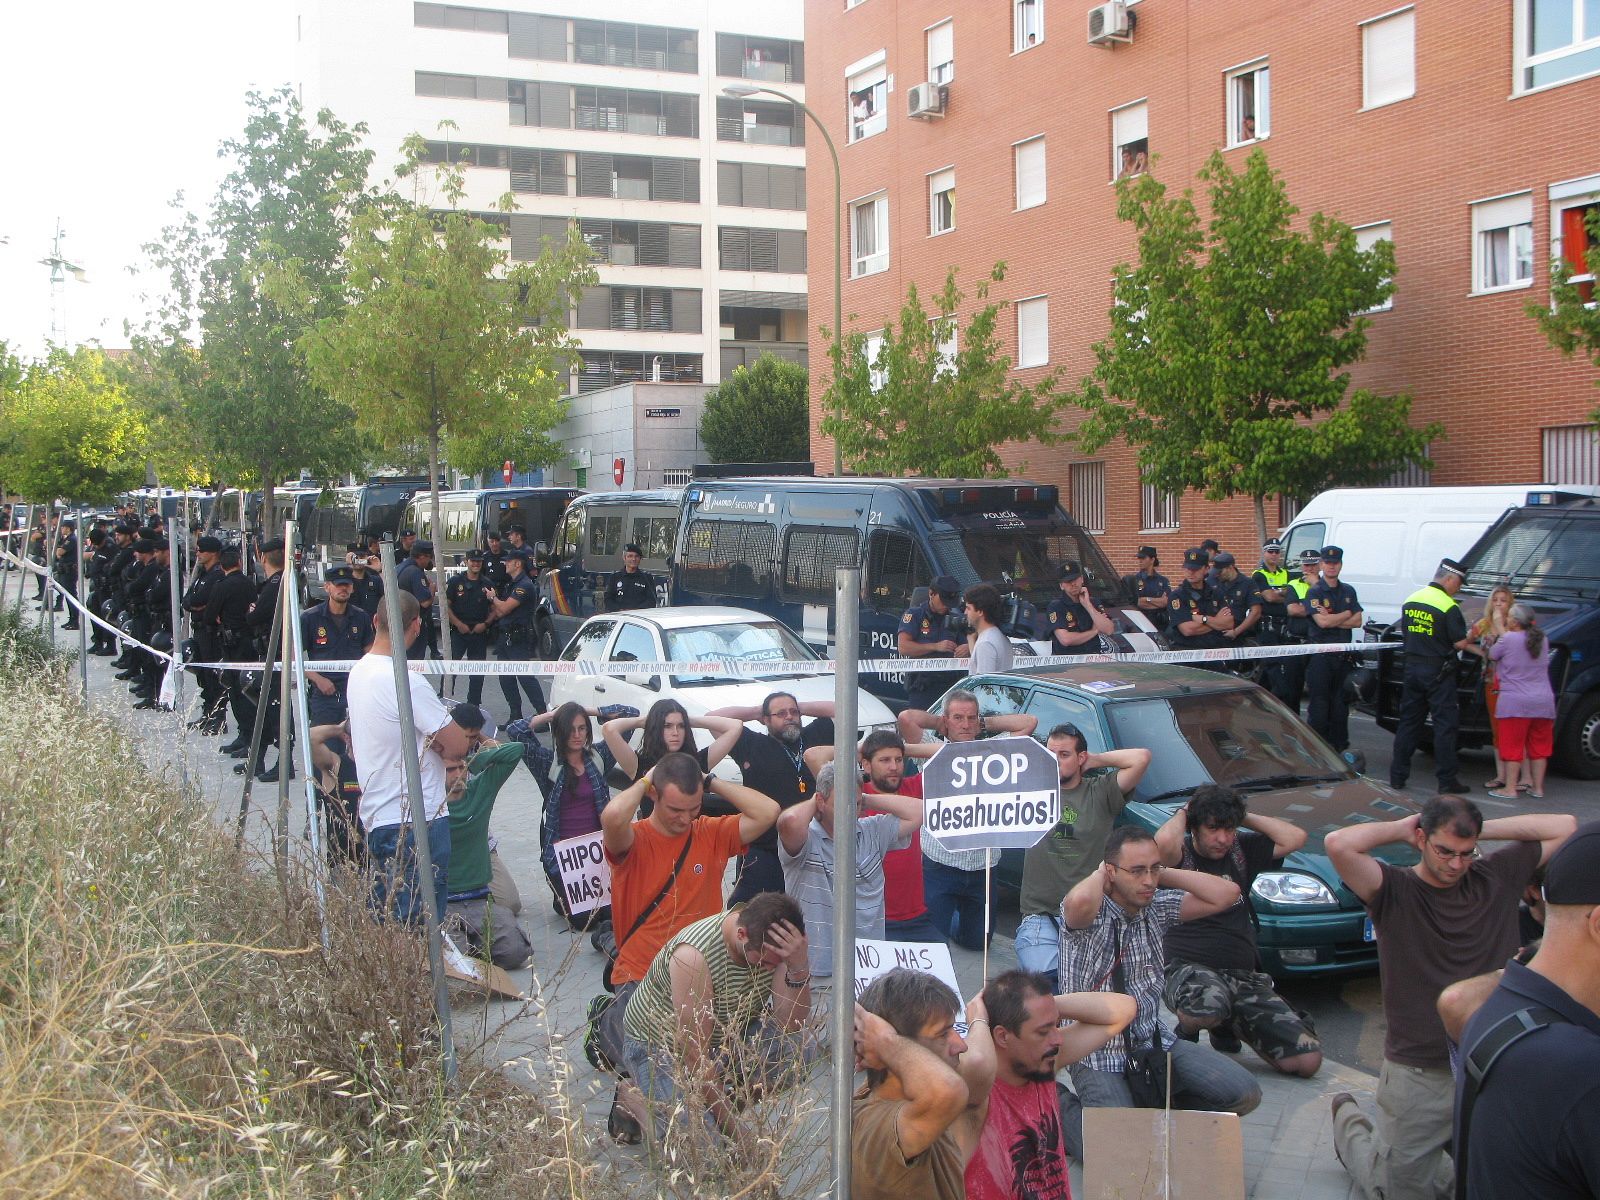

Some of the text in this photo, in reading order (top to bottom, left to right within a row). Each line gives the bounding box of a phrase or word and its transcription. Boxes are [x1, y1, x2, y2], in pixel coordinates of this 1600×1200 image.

[399, 492, 410, 500] 22
[869, 511, 882, 525] 21
[951, 753, 1029, 789] STOP
[928, 792, 1055, 832] desahucios!
[558, 839, 604, 873] HIPO
[566, 873, 604, 905] MÁS
[855, 944, 933, 970] NO MAS
